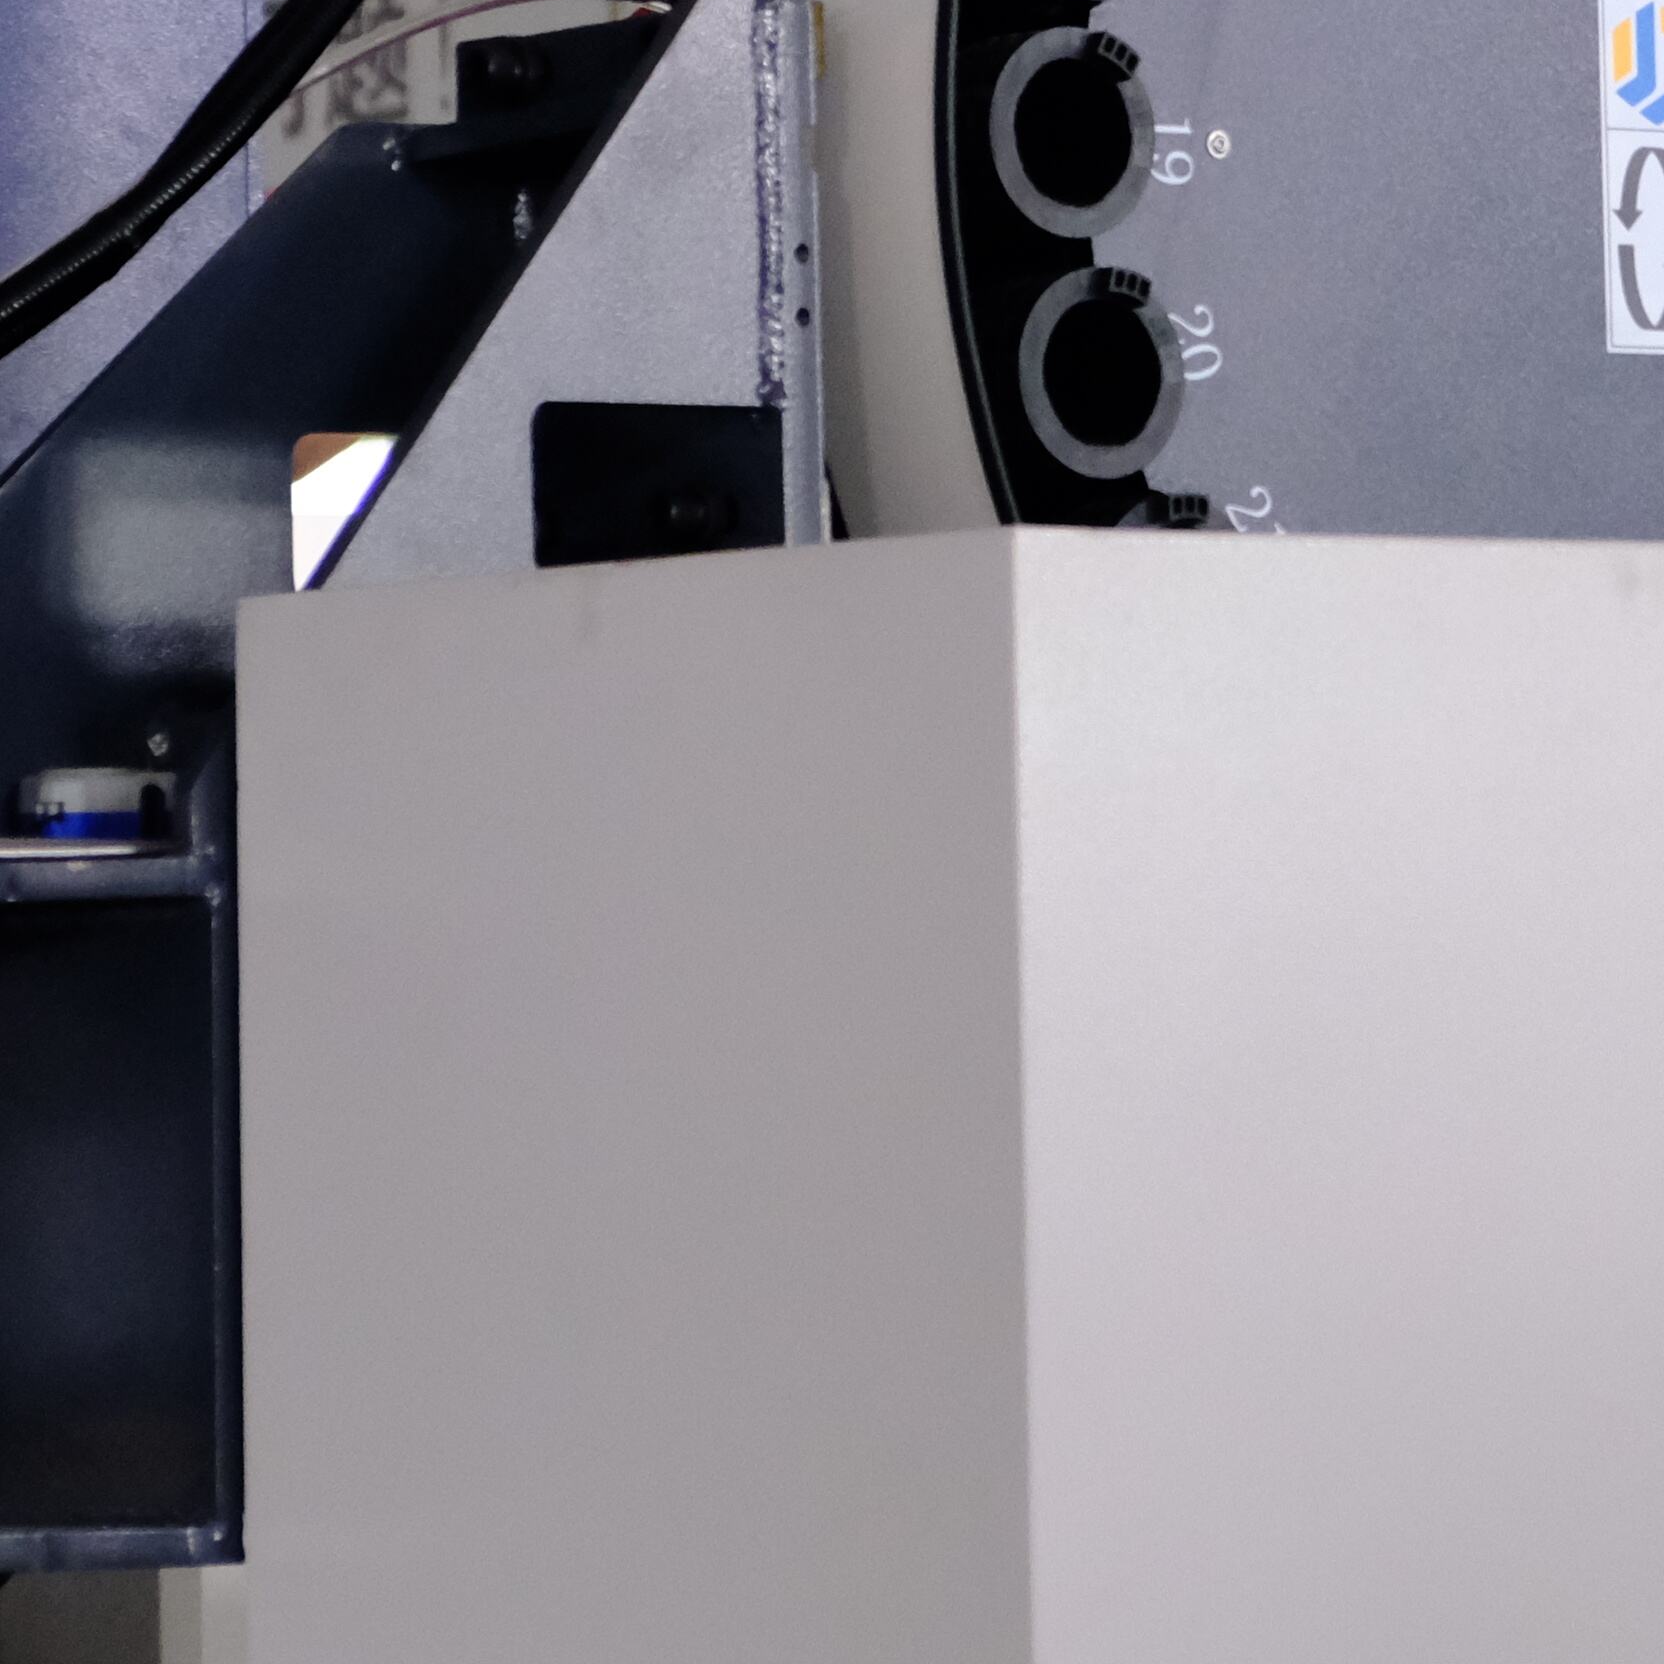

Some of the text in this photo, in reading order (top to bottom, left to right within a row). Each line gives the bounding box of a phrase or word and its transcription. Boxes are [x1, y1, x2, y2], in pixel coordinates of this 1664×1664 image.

[1151, 118, 1194, 185] 19
[1168, 304, 1223, 380] 20
[1225, 484, 1286, 534] 2
